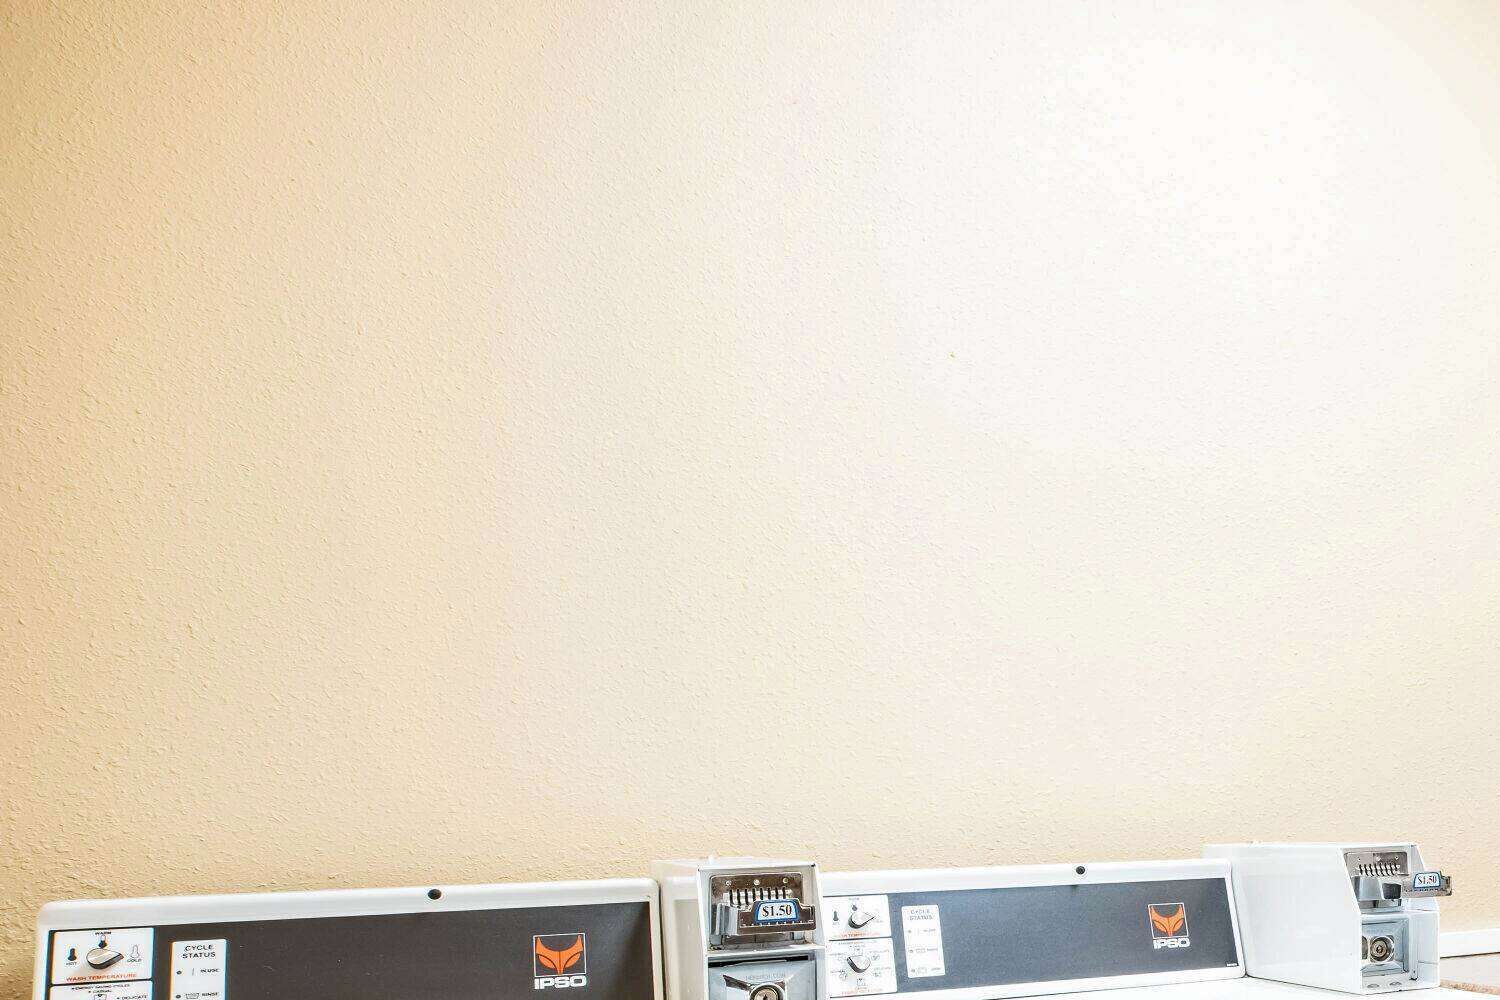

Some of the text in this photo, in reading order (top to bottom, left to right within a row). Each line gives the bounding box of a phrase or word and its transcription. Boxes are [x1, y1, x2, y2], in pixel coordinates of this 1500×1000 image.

[1417, 875, 1437, 885] $1.50
[762, 905, 792, 918] $1.50
[1153, 937, 1190, 949] IPSO
[534, 975, 587, 990] IPSO
